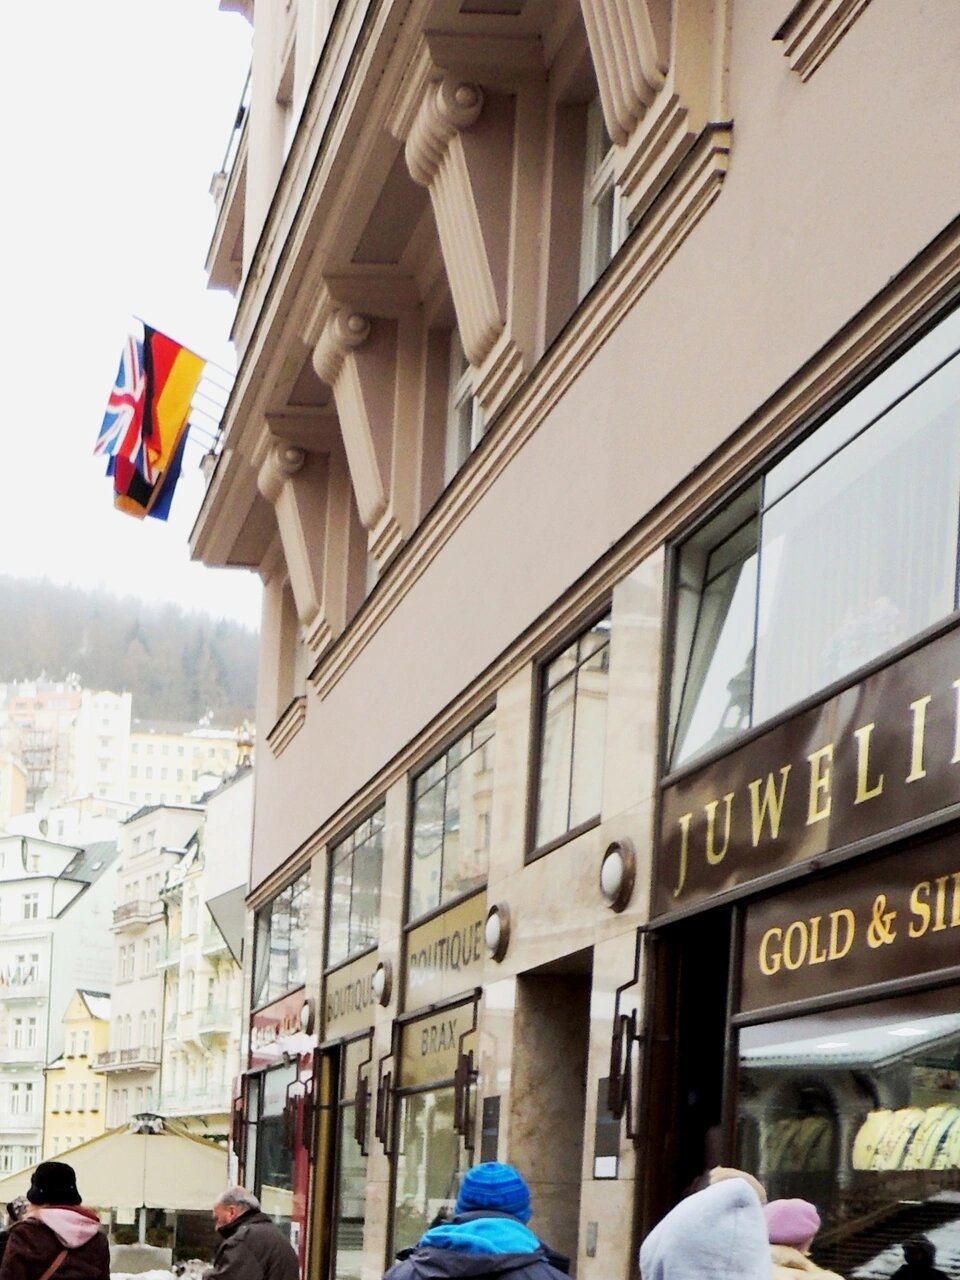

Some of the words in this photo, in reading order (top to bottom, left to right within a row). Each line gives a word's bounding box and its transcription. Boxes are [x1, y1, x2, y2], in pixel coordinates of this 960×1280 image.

[410, 920, 482, 987] BOUTIQUE
[759, 908, 855, 976] GOLD
[867, 893, 897, 949] &
[421, 1019, 458, 1056] BRAX
